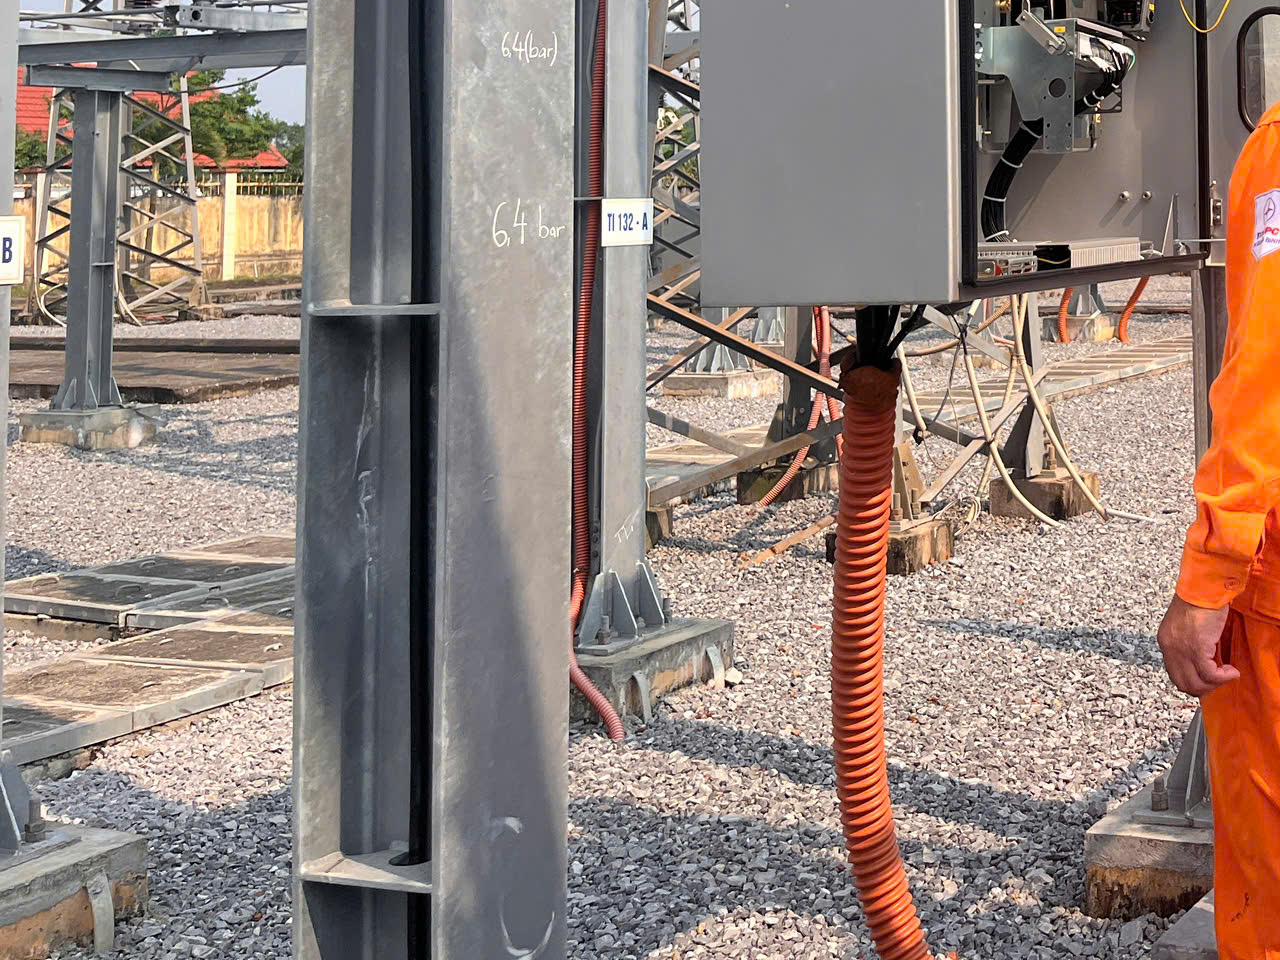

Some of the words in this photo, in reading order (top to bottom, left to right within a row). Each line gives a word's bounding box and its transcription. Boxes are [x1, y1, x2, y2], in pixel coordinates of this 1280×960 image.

[538, 204, 566, 239] bar
[618, 212, 634, 232] 132
[642, 212, 648, 230] A
[2, 237, 13, 263] B
